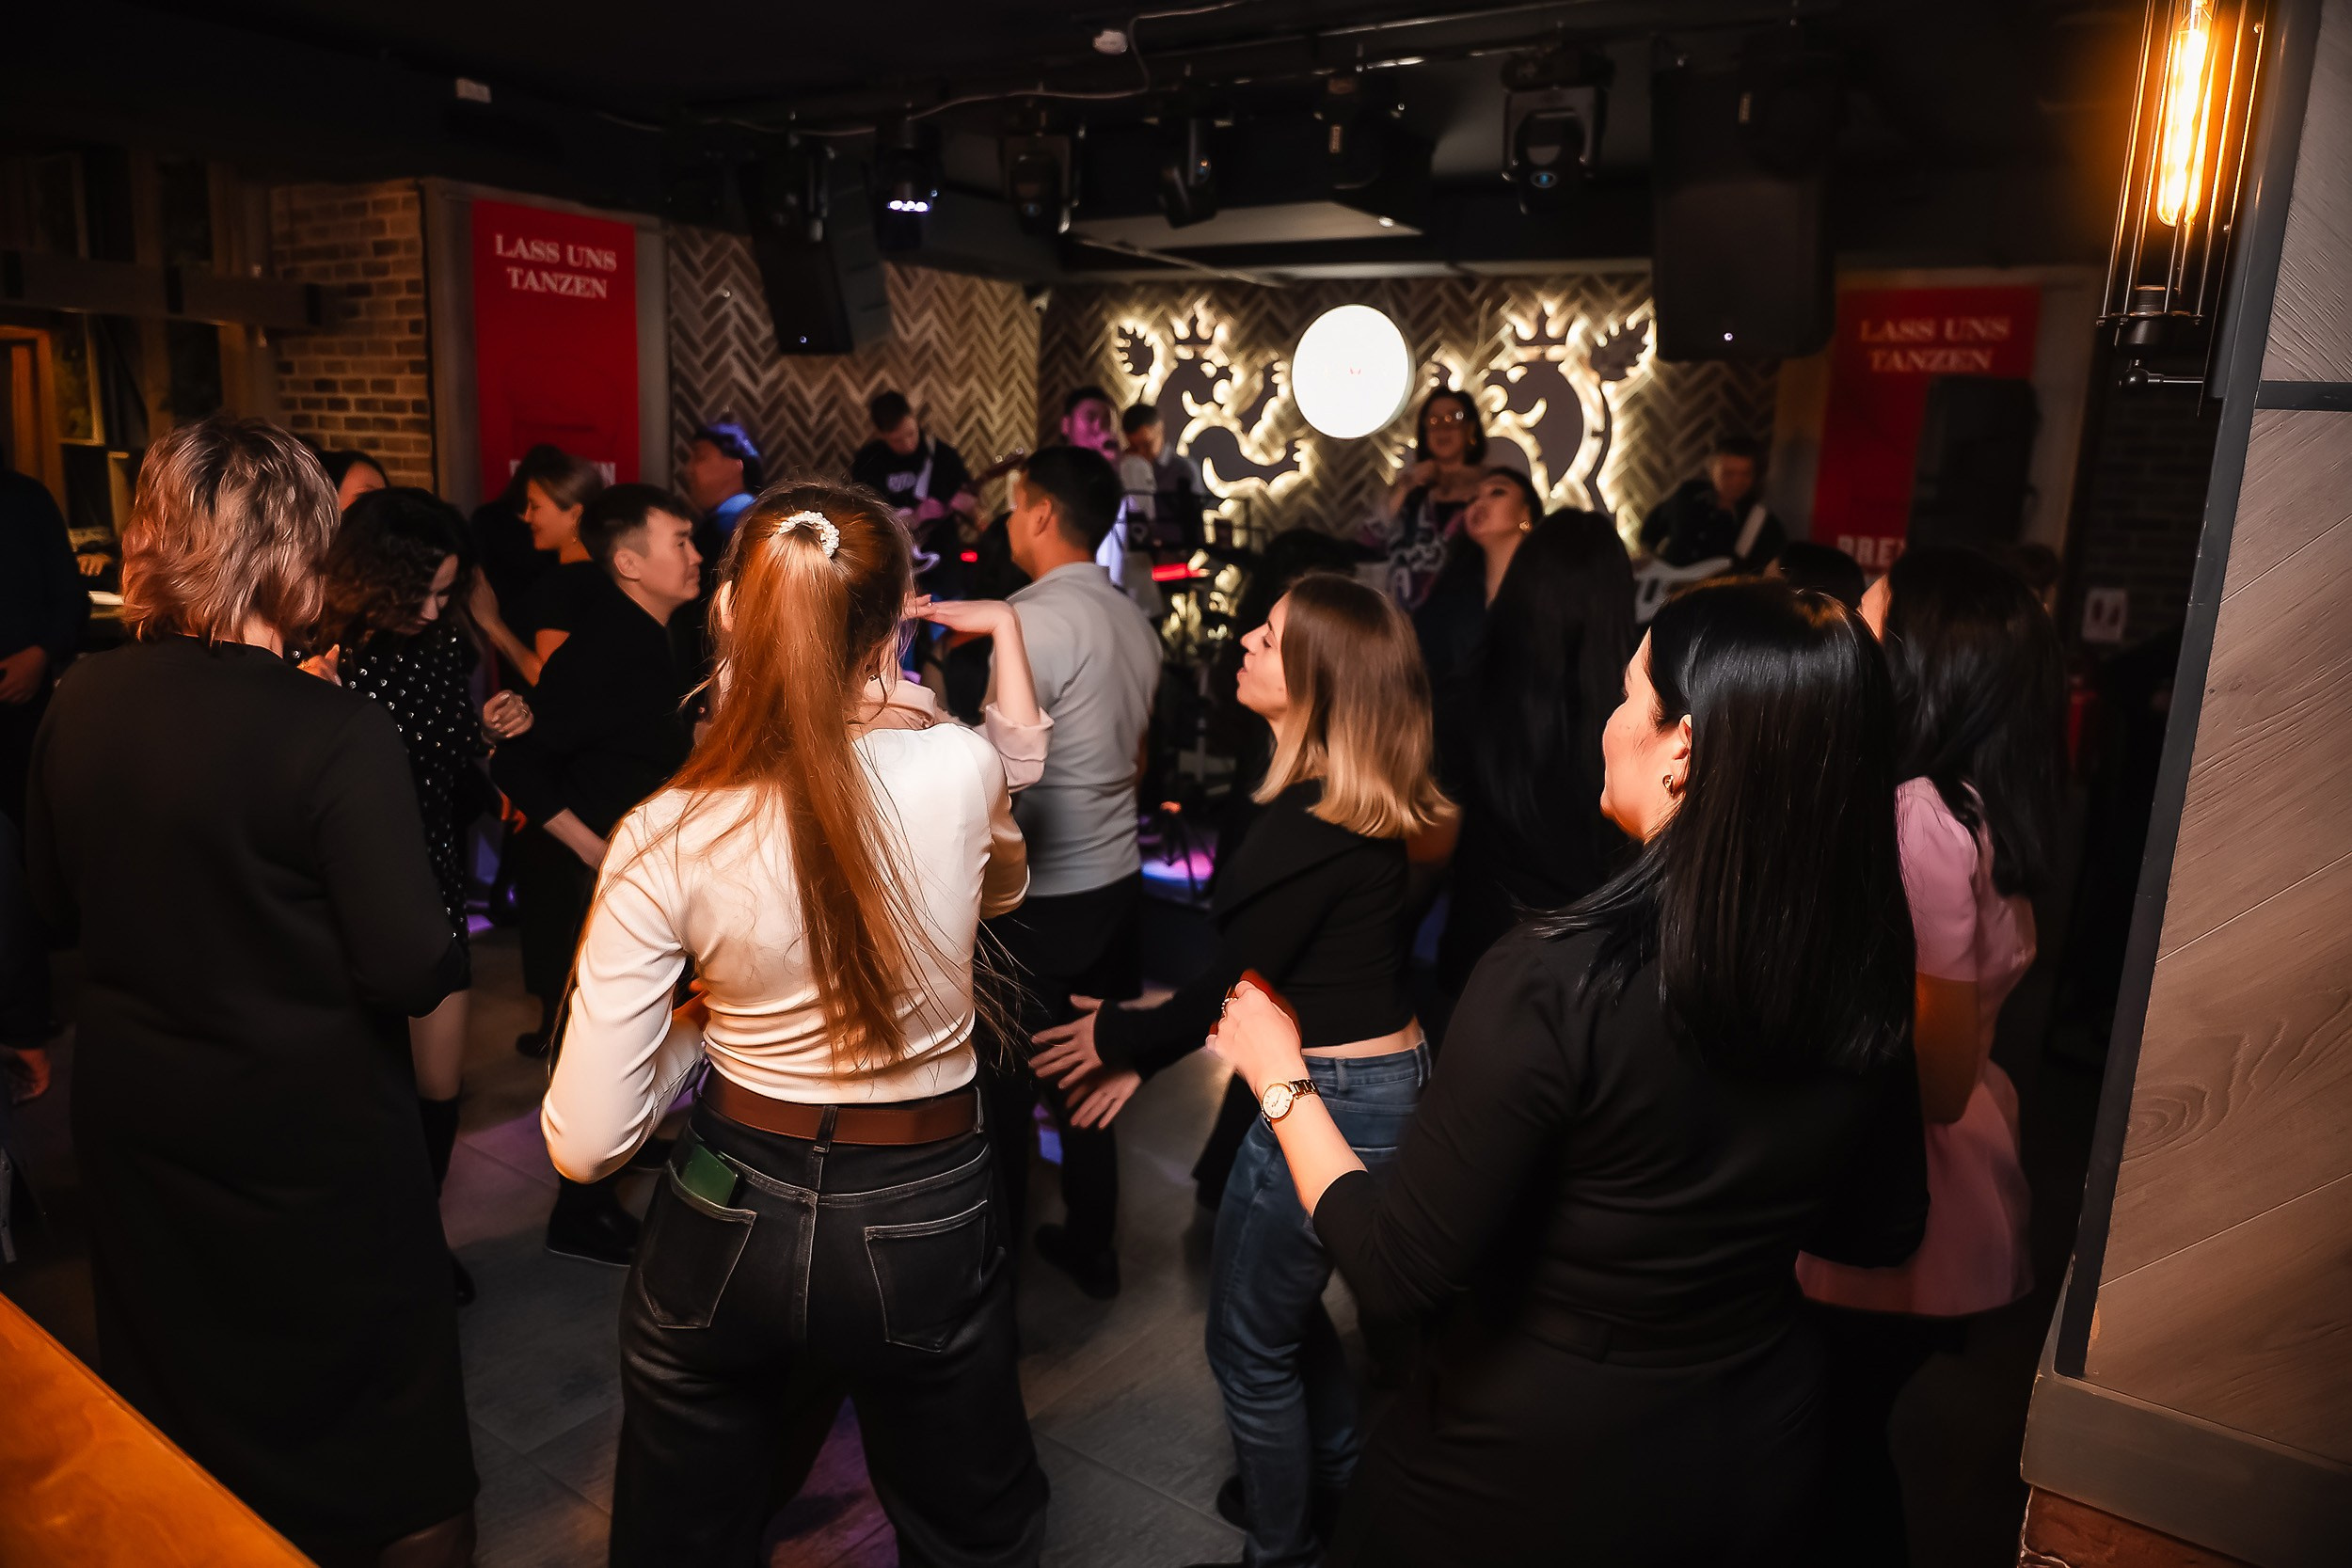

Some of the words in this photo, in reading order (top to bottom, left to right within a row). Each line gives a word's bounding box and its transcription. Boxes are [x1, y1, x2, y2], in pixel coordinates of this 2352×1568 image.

[495, 233, 561, 264] LASS
[566, 244, 617, 273] UNS
[506, 266, 608, 299] TANZEN
[1861, 318, 1935, 342] LASS
[1944, 316, 2011, 341] UNS
[1868, 348, 1993, 372] TANZEN
